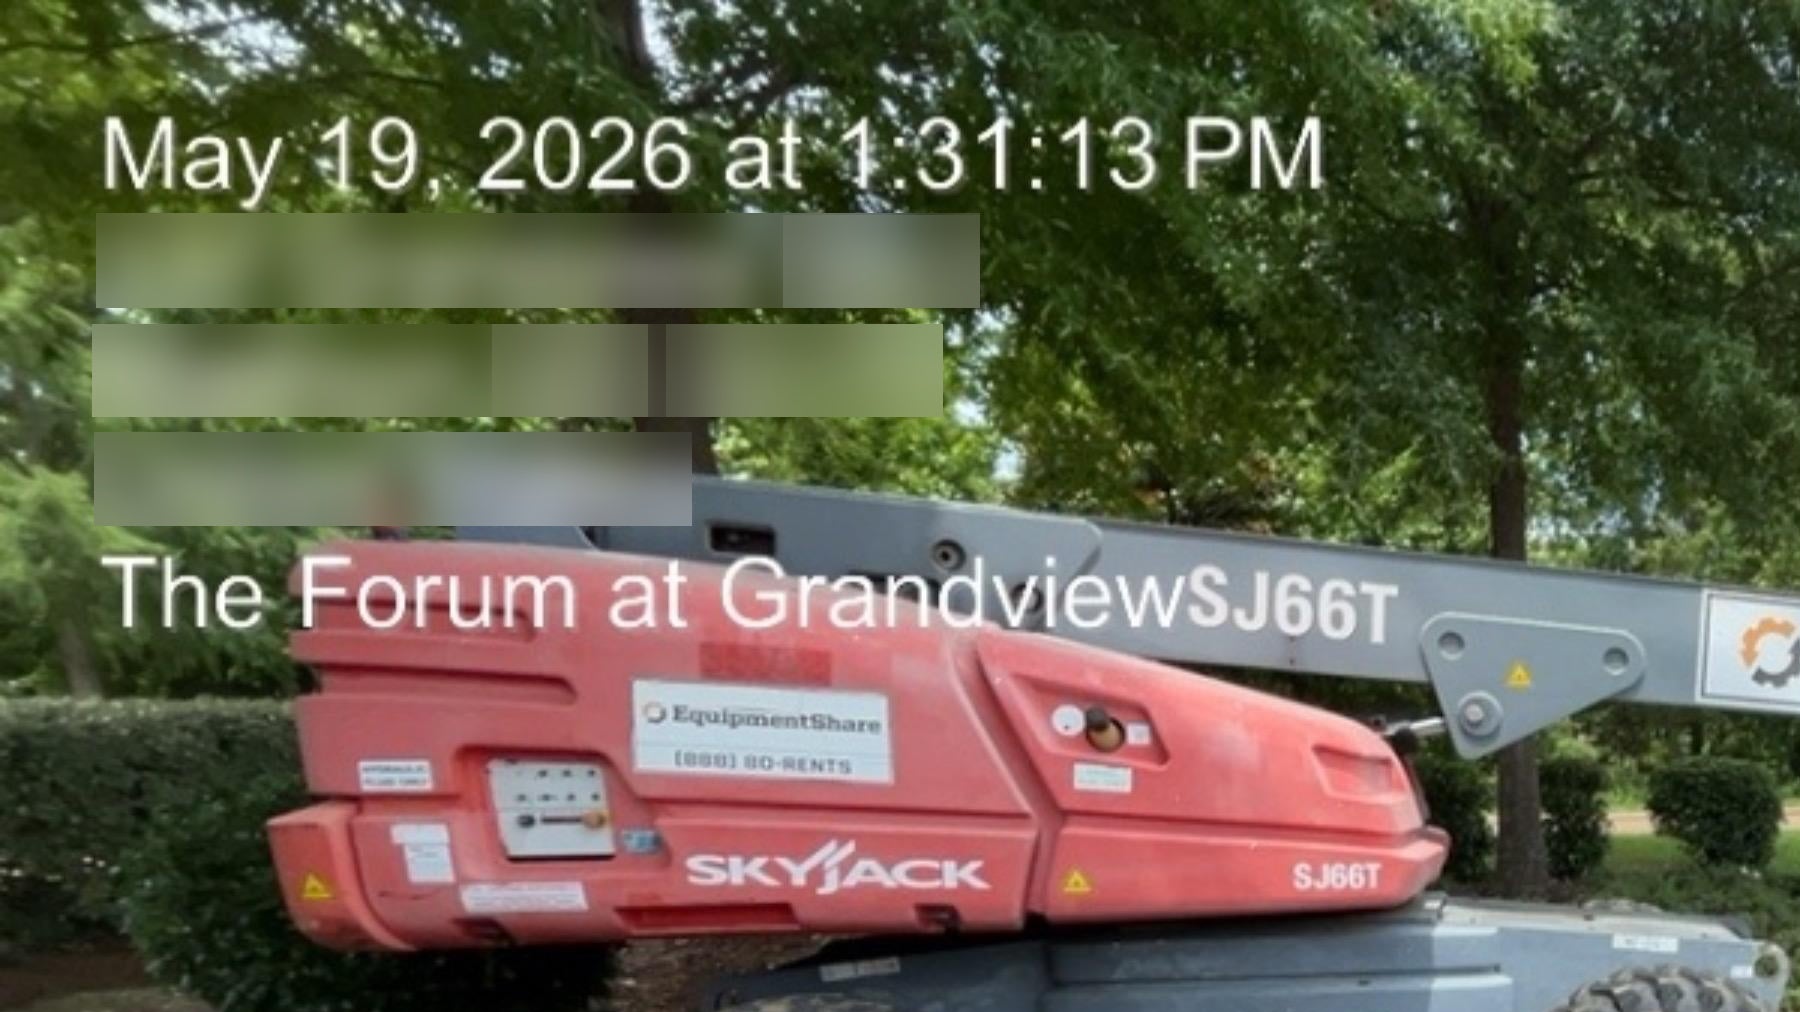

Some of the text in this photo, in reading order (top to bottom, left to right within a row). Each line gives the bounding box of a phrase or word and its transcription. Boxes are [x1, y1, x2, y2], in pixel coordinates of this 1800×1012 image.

[1187, 563, 1399, 645] SJ66T
[672, 704, 883, 735] EquipmentShare
[685, 839, 992, 896] SKYJACK
[1293, 862, 1383, 889] SJ66T
